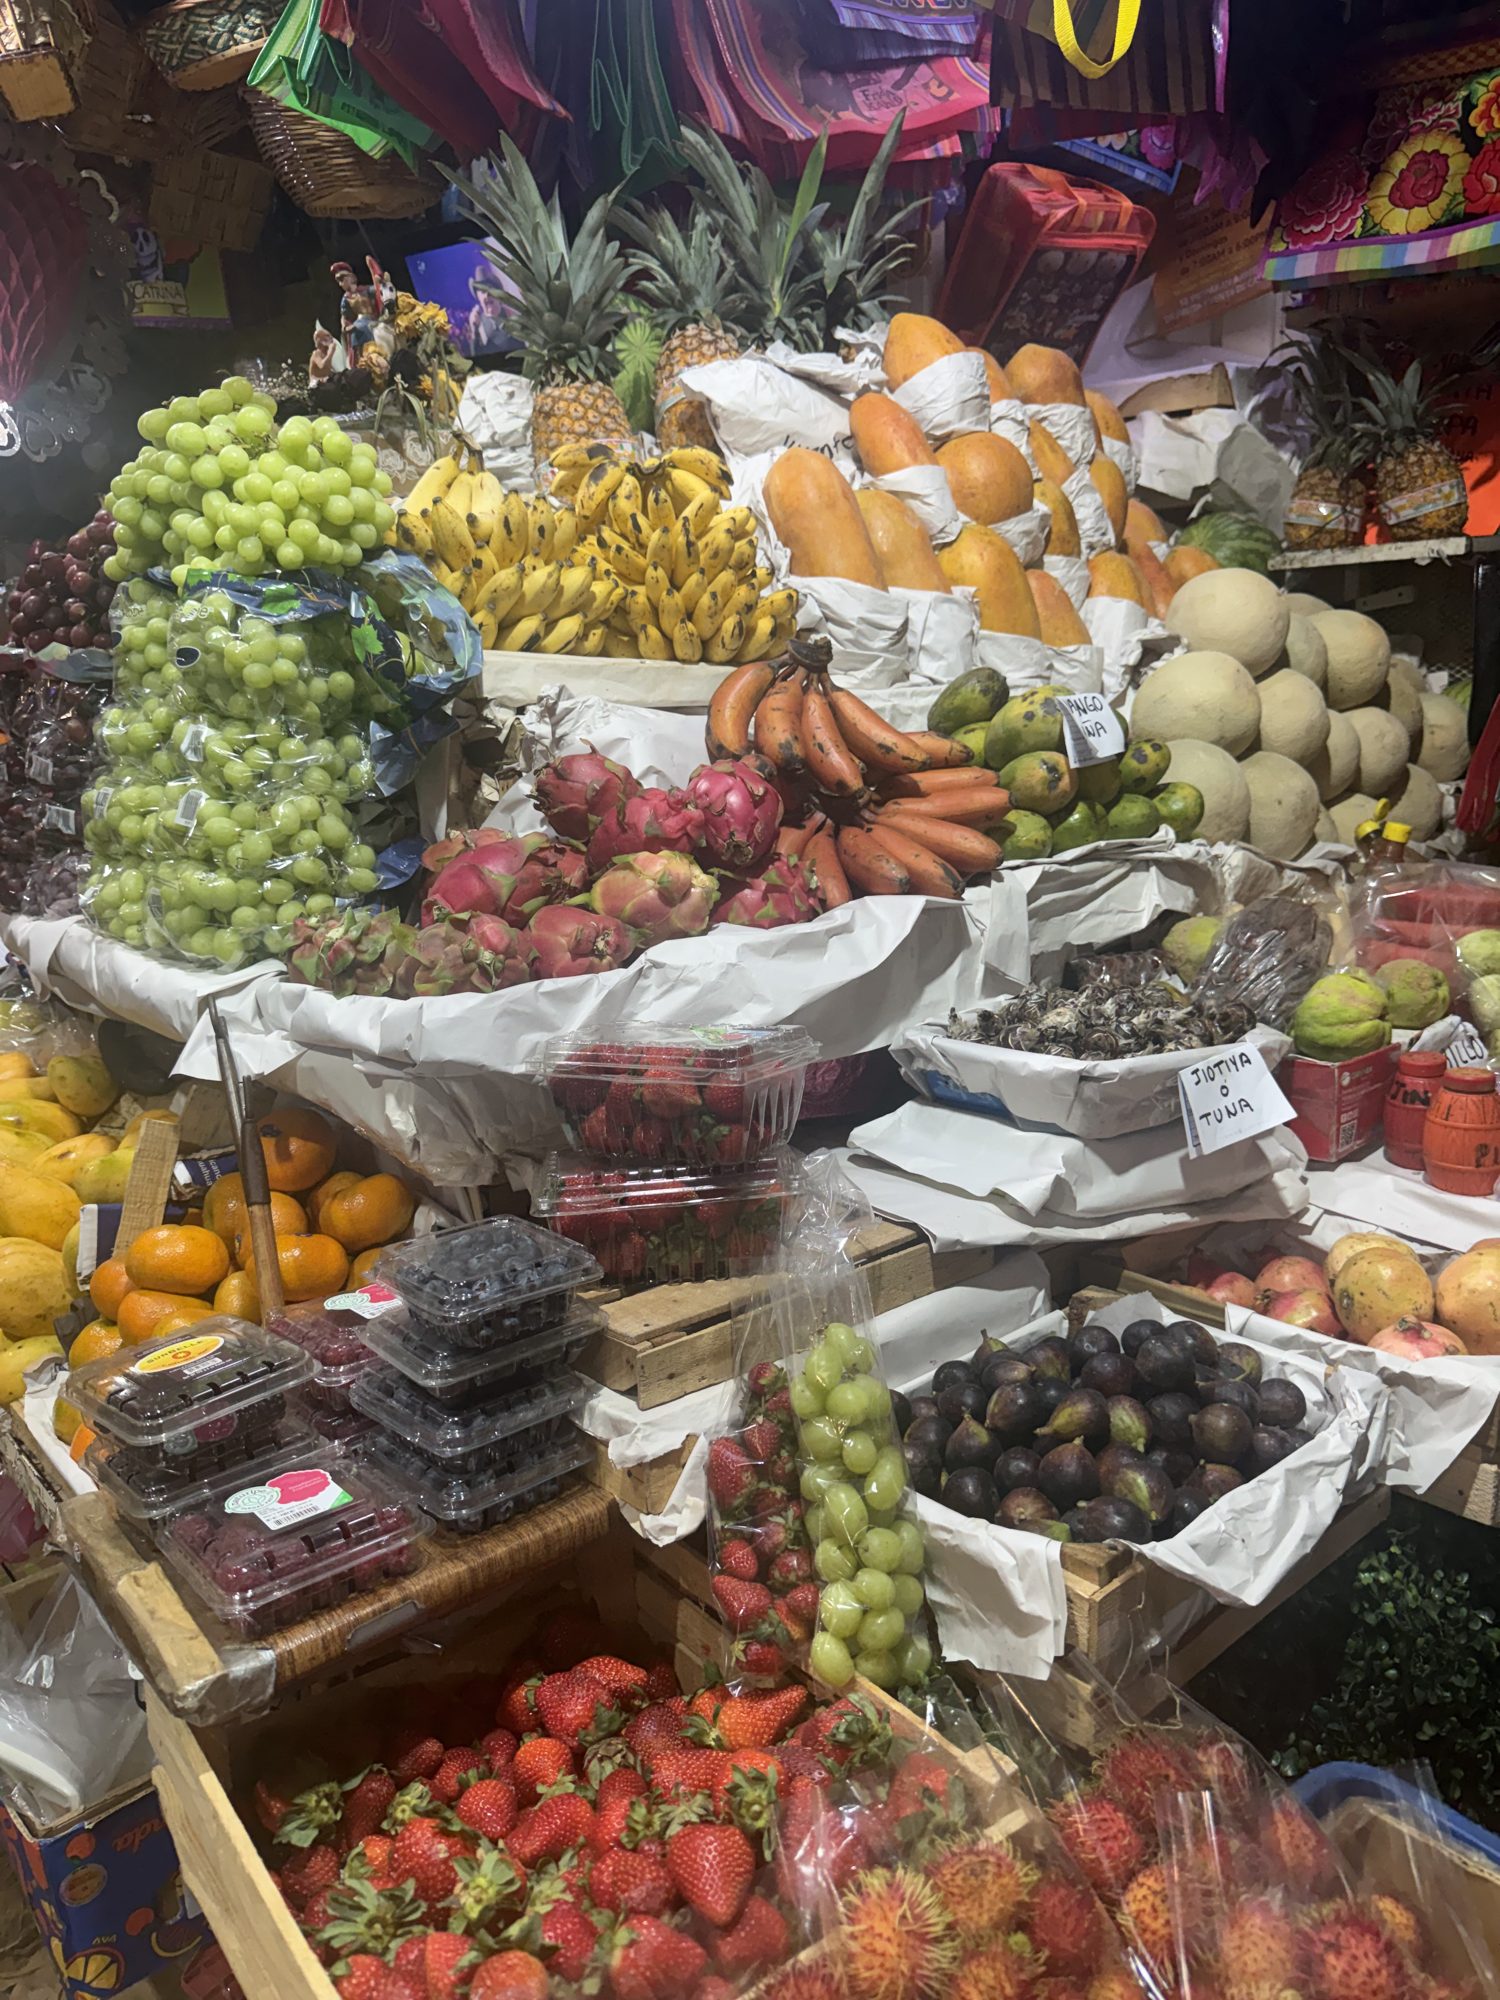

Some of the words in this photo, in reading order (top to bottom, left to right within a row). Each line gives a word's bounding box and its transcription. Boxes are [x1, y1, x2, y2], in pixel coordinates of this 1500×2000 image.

[133, 283, 184, 299] CATRINA
[1066, 696, 1103, 716] ANGO
[1199, 1098, 1254, 1126] TUNA
